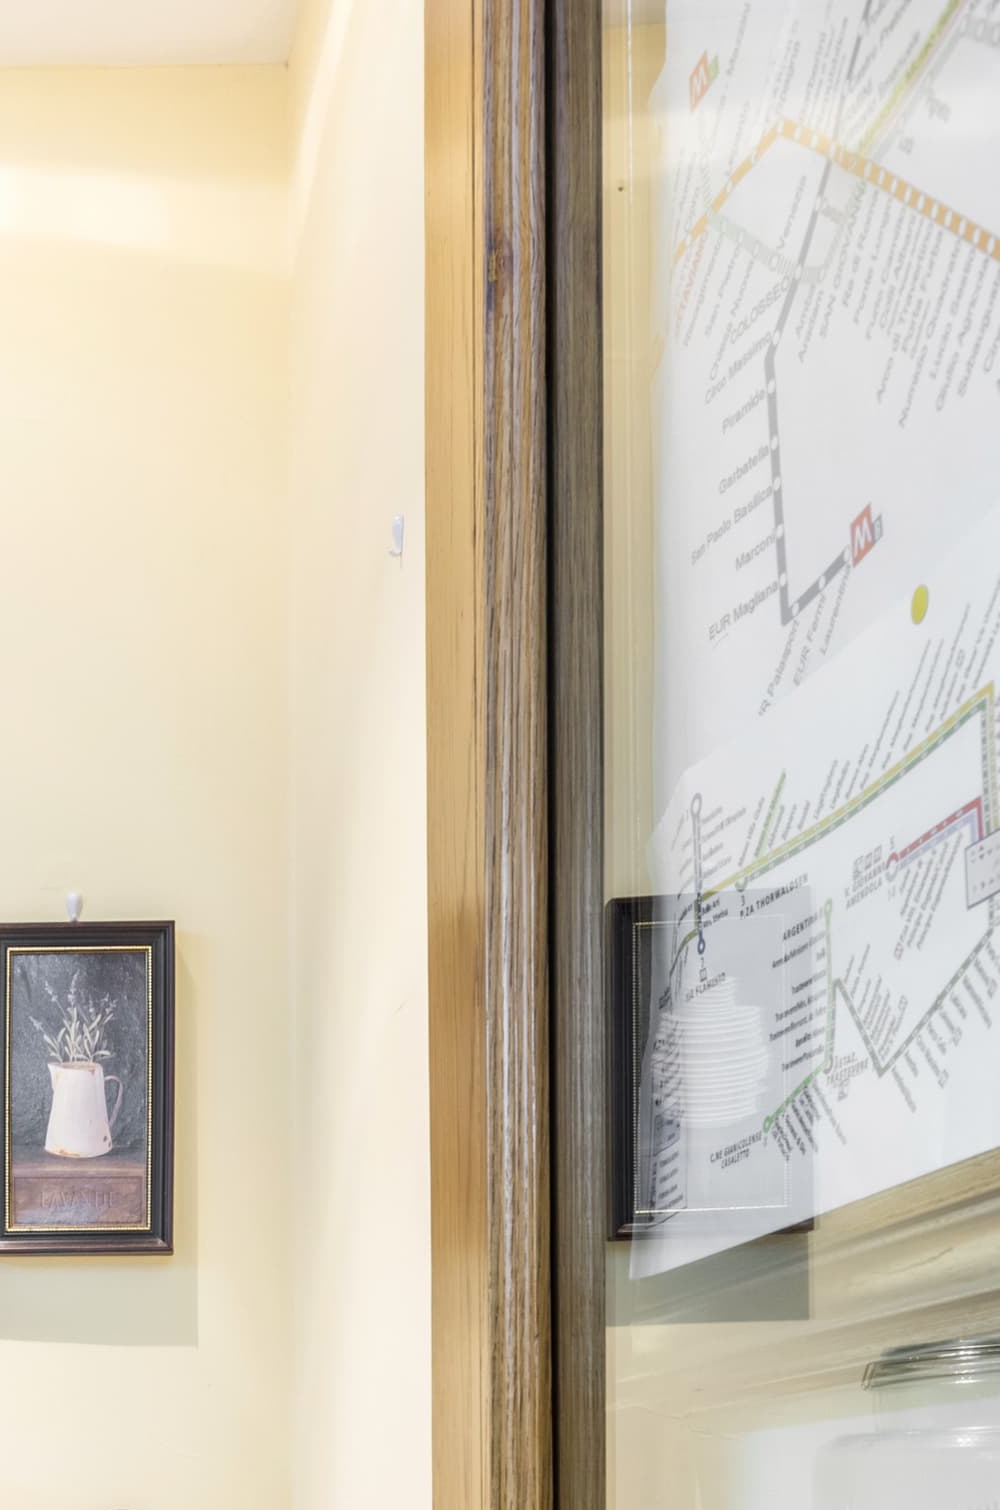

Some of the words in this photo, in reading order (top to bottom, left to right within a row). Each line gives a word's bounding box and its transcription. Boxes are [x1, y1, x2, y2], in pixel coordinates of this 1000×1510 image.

[721, 388, 766, 433] Piramide
[717, 443, 769, 495] Garbatella
[733, 485, 773, 523] Basilica
[732, 578, 778, 626] Magliana
